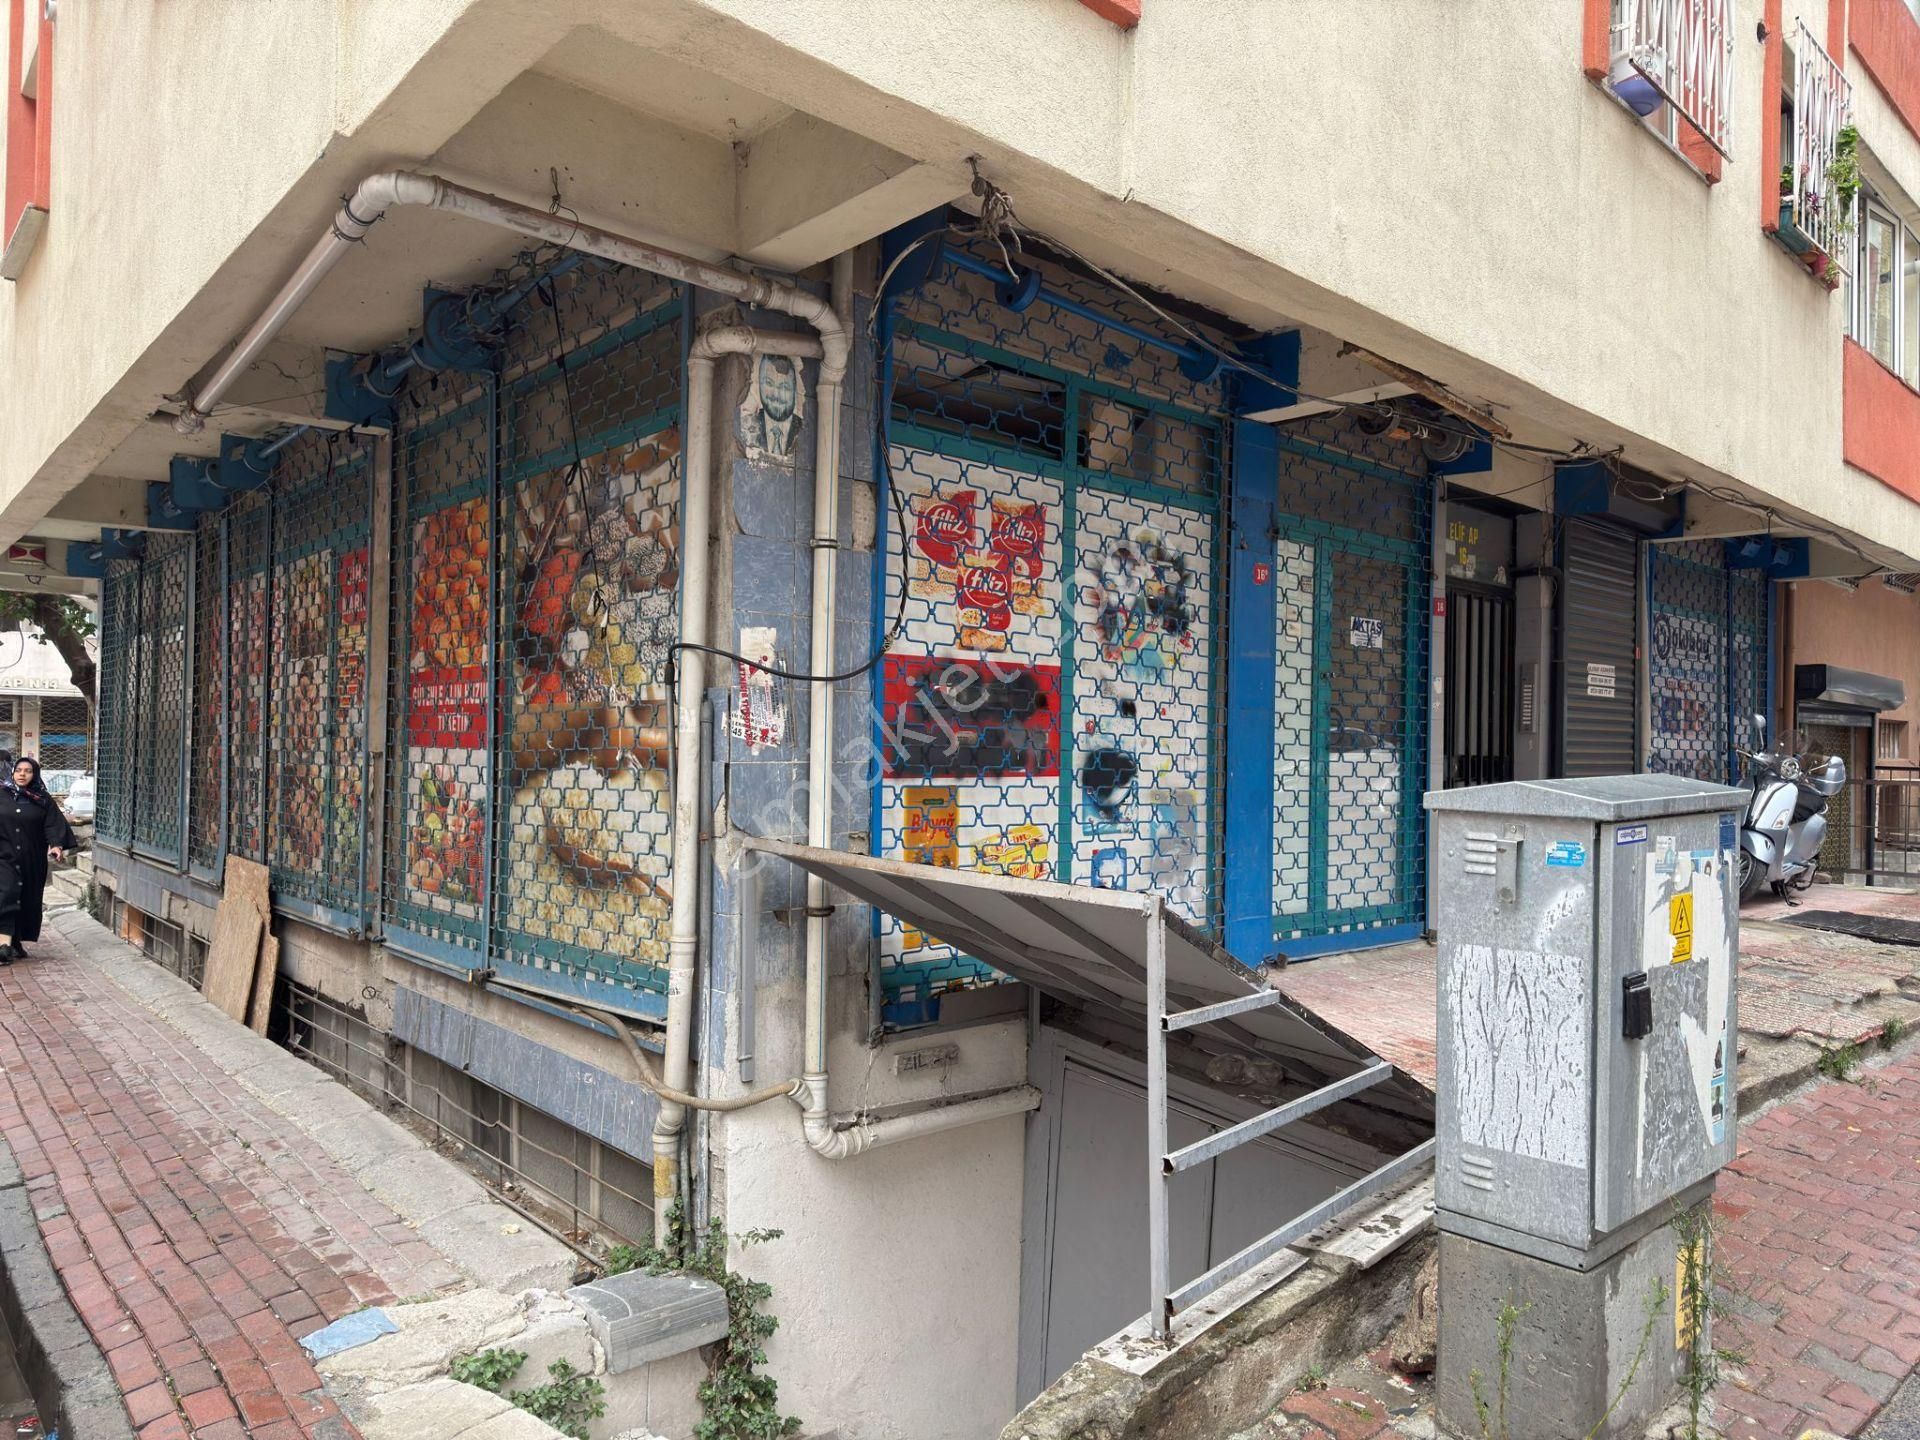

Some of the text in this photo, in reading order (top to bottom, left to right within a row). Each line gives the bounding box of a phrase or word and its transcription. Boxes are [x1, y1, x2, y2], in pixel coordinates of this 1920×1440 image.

[930, 508, 968, 534] filiz
[1003, 515, 1036, 542] filiz
[1468, 527, 1479, 544] AP
[968, 569, 1006, 596] filiz
